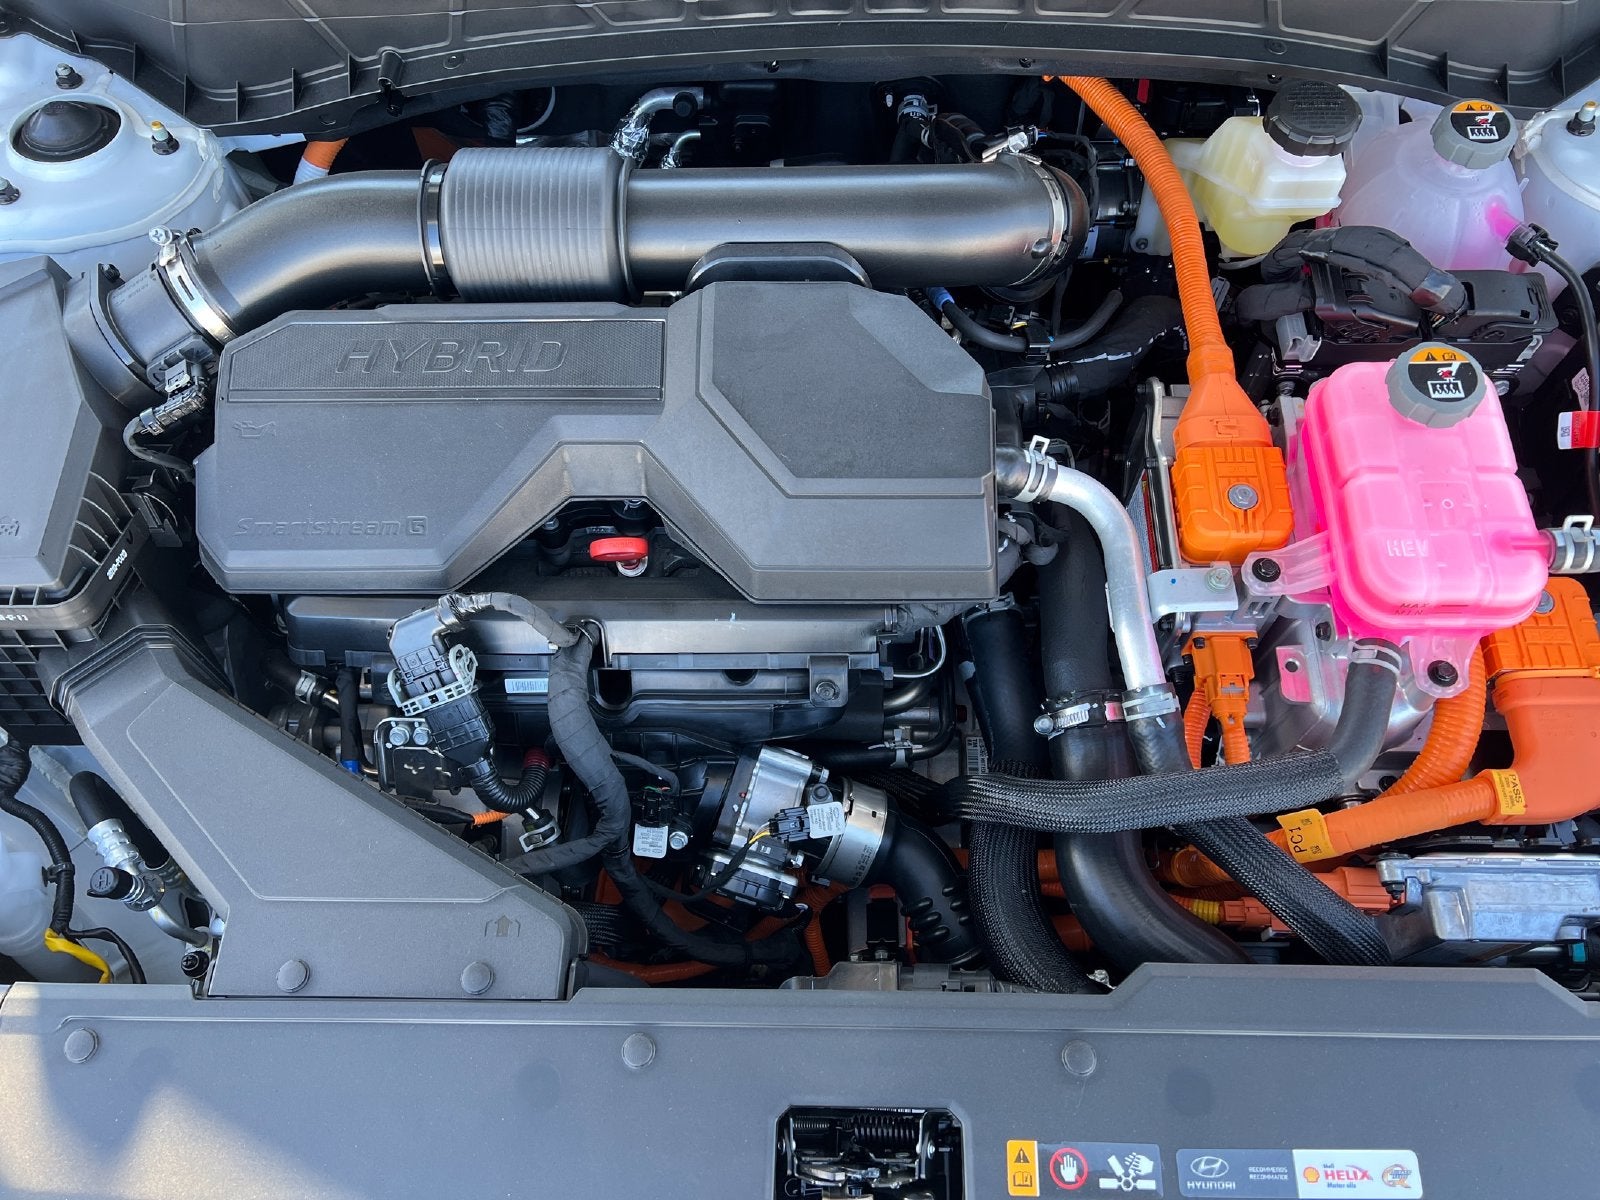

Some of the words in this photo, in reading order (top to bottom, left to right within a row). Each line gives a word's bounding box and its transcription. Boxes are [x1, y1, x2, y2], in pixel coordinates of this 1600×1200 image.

[334, 339, 568, 373] HYBRID
[234, 517, 401, 536] Smartstream
[1386, 539, 1429, 557] HEV
[1509, 774, 1523, 803] PASS
[1289, 826, 1307, 853] PC1
[1324, 1169, 1370, 1180] HELIX
[1187, 1181, 1236, 1190] HYUNDAI
